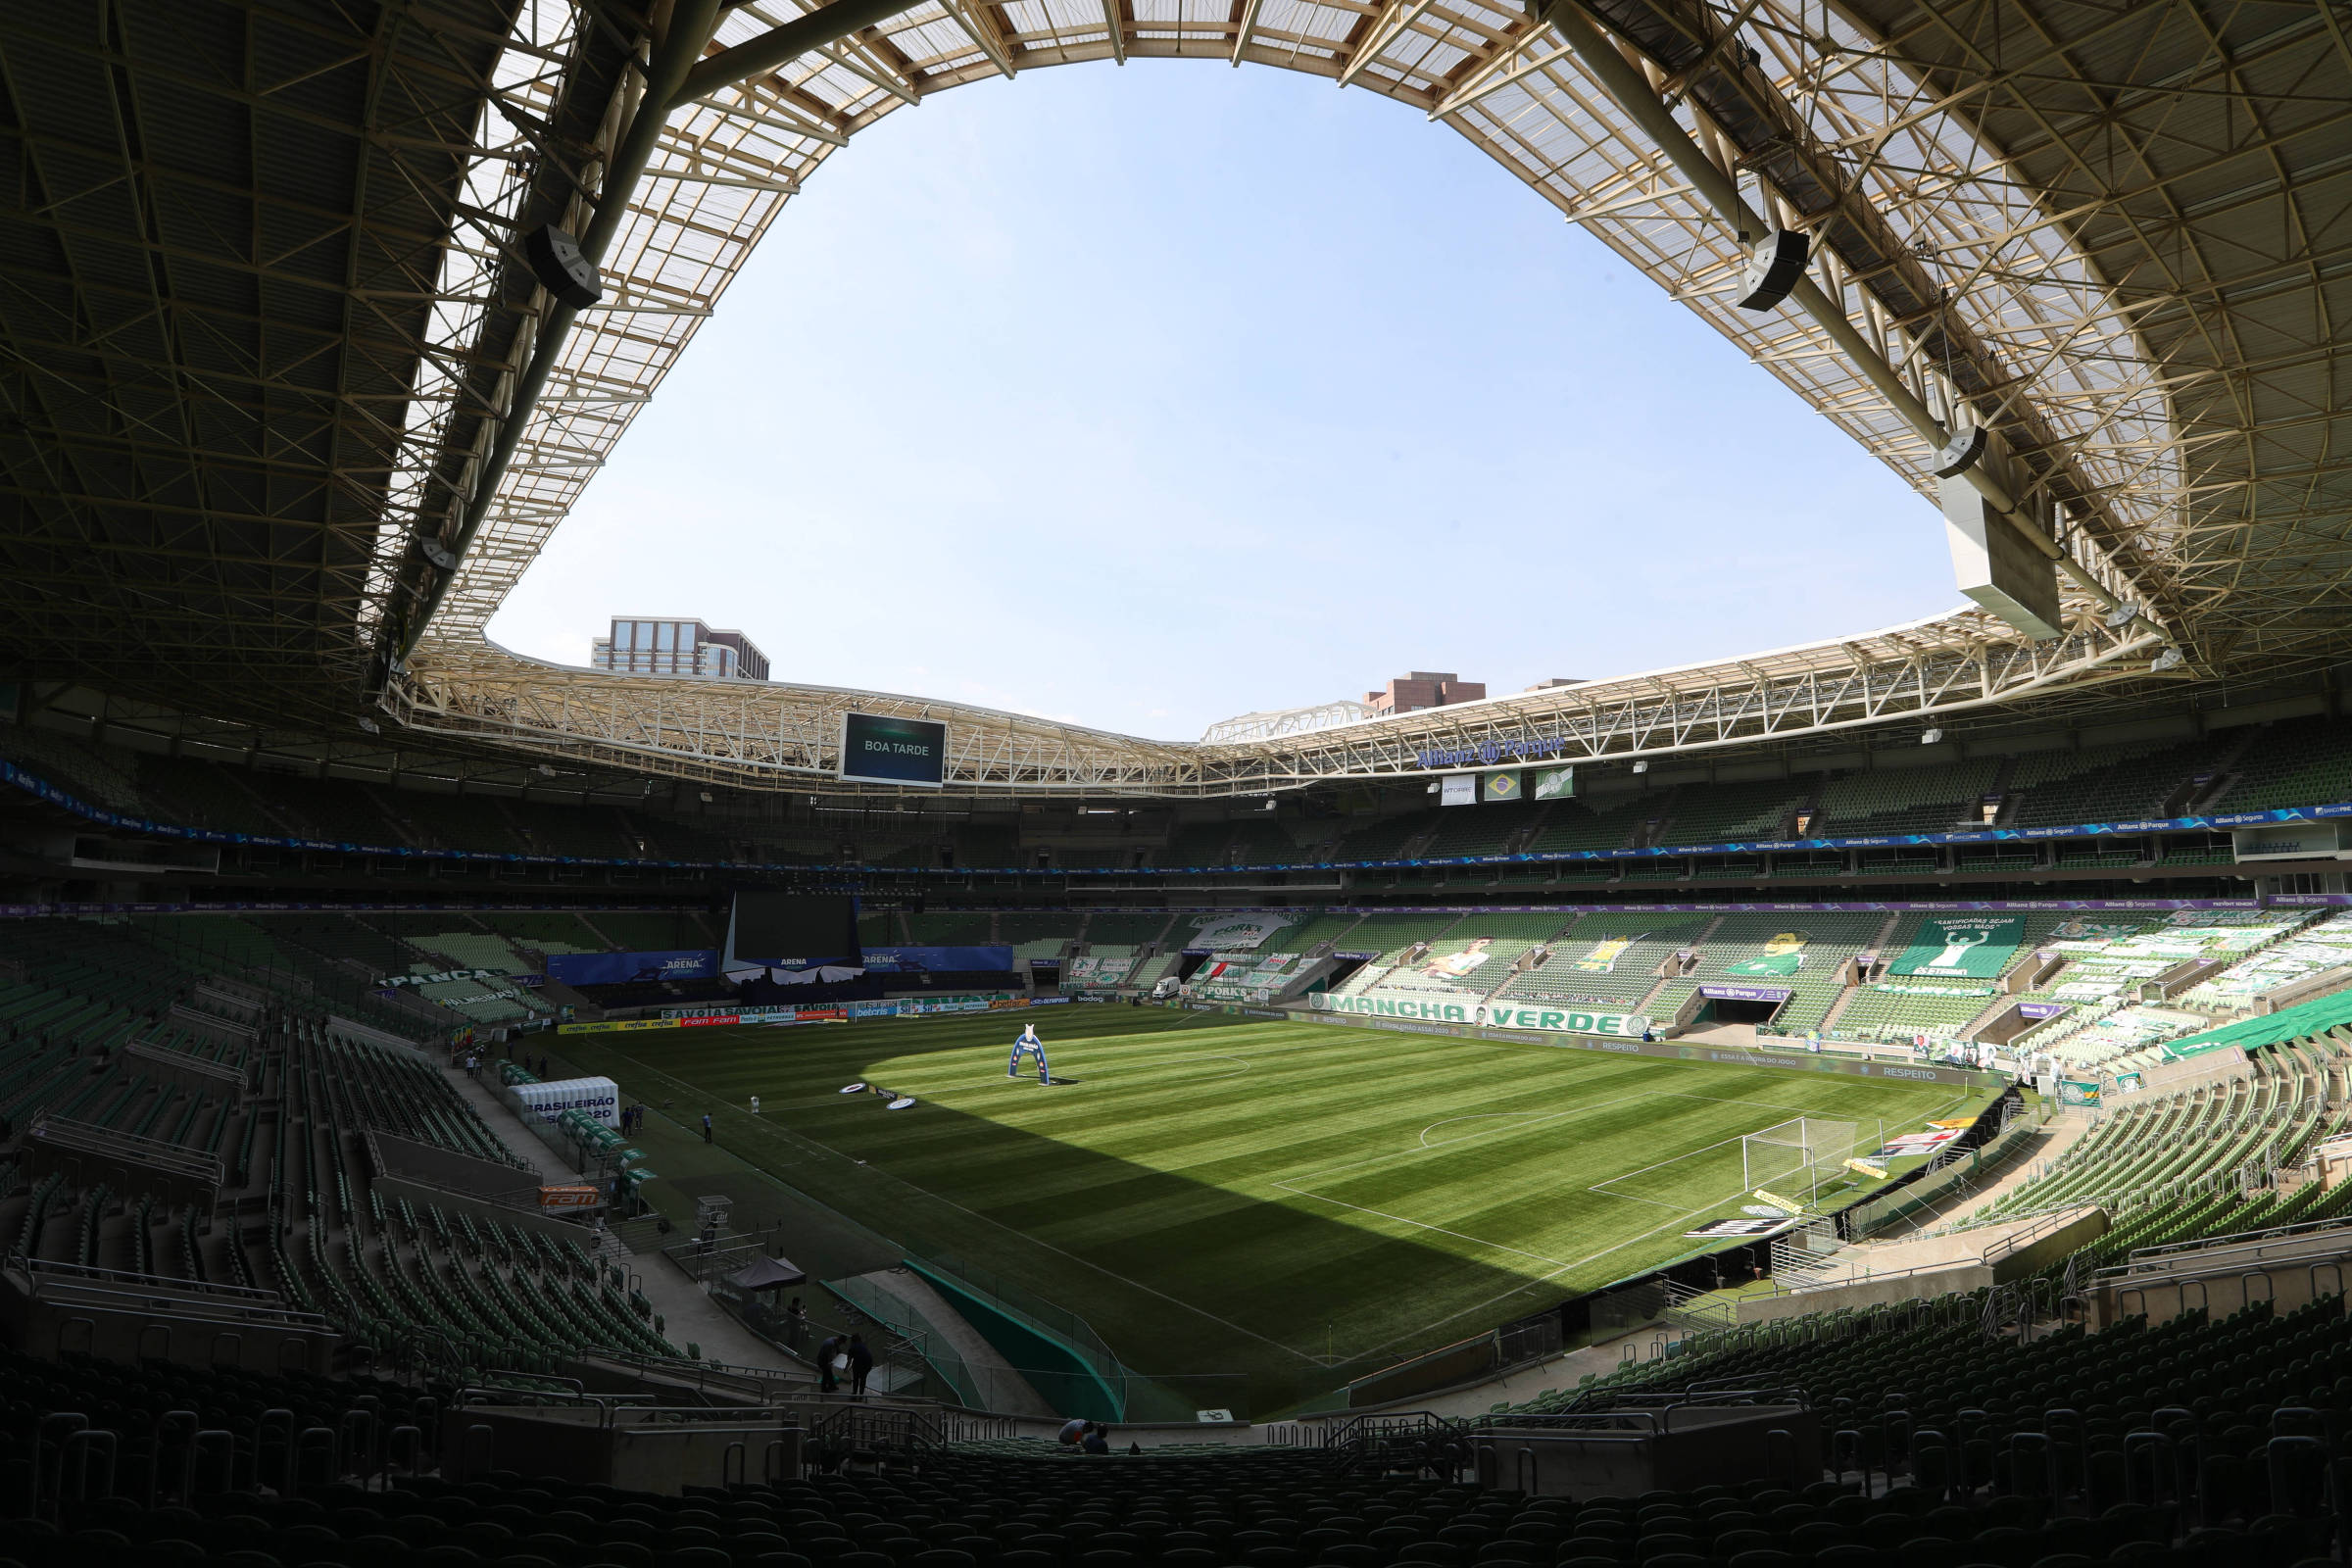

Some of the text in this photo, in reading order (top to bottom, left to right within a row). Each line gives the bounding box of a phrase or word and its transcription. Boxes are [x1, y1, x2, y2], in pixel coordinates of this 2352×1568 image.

[864, 740, 929, 756] BOA TARDE
[1416, 736, 1565, 767] Allianz Parque
[1207, 986, 1248, 997] PORK'S
[1329, 995, 1623, 1034] MANCHA VERDE
[1602, 1042, 1639, 1052] RESPEITO
[1884, 1066, 1936, 1080] RESPEITO
[525, 1096, 615, 1113] BRASILEIRÃO
